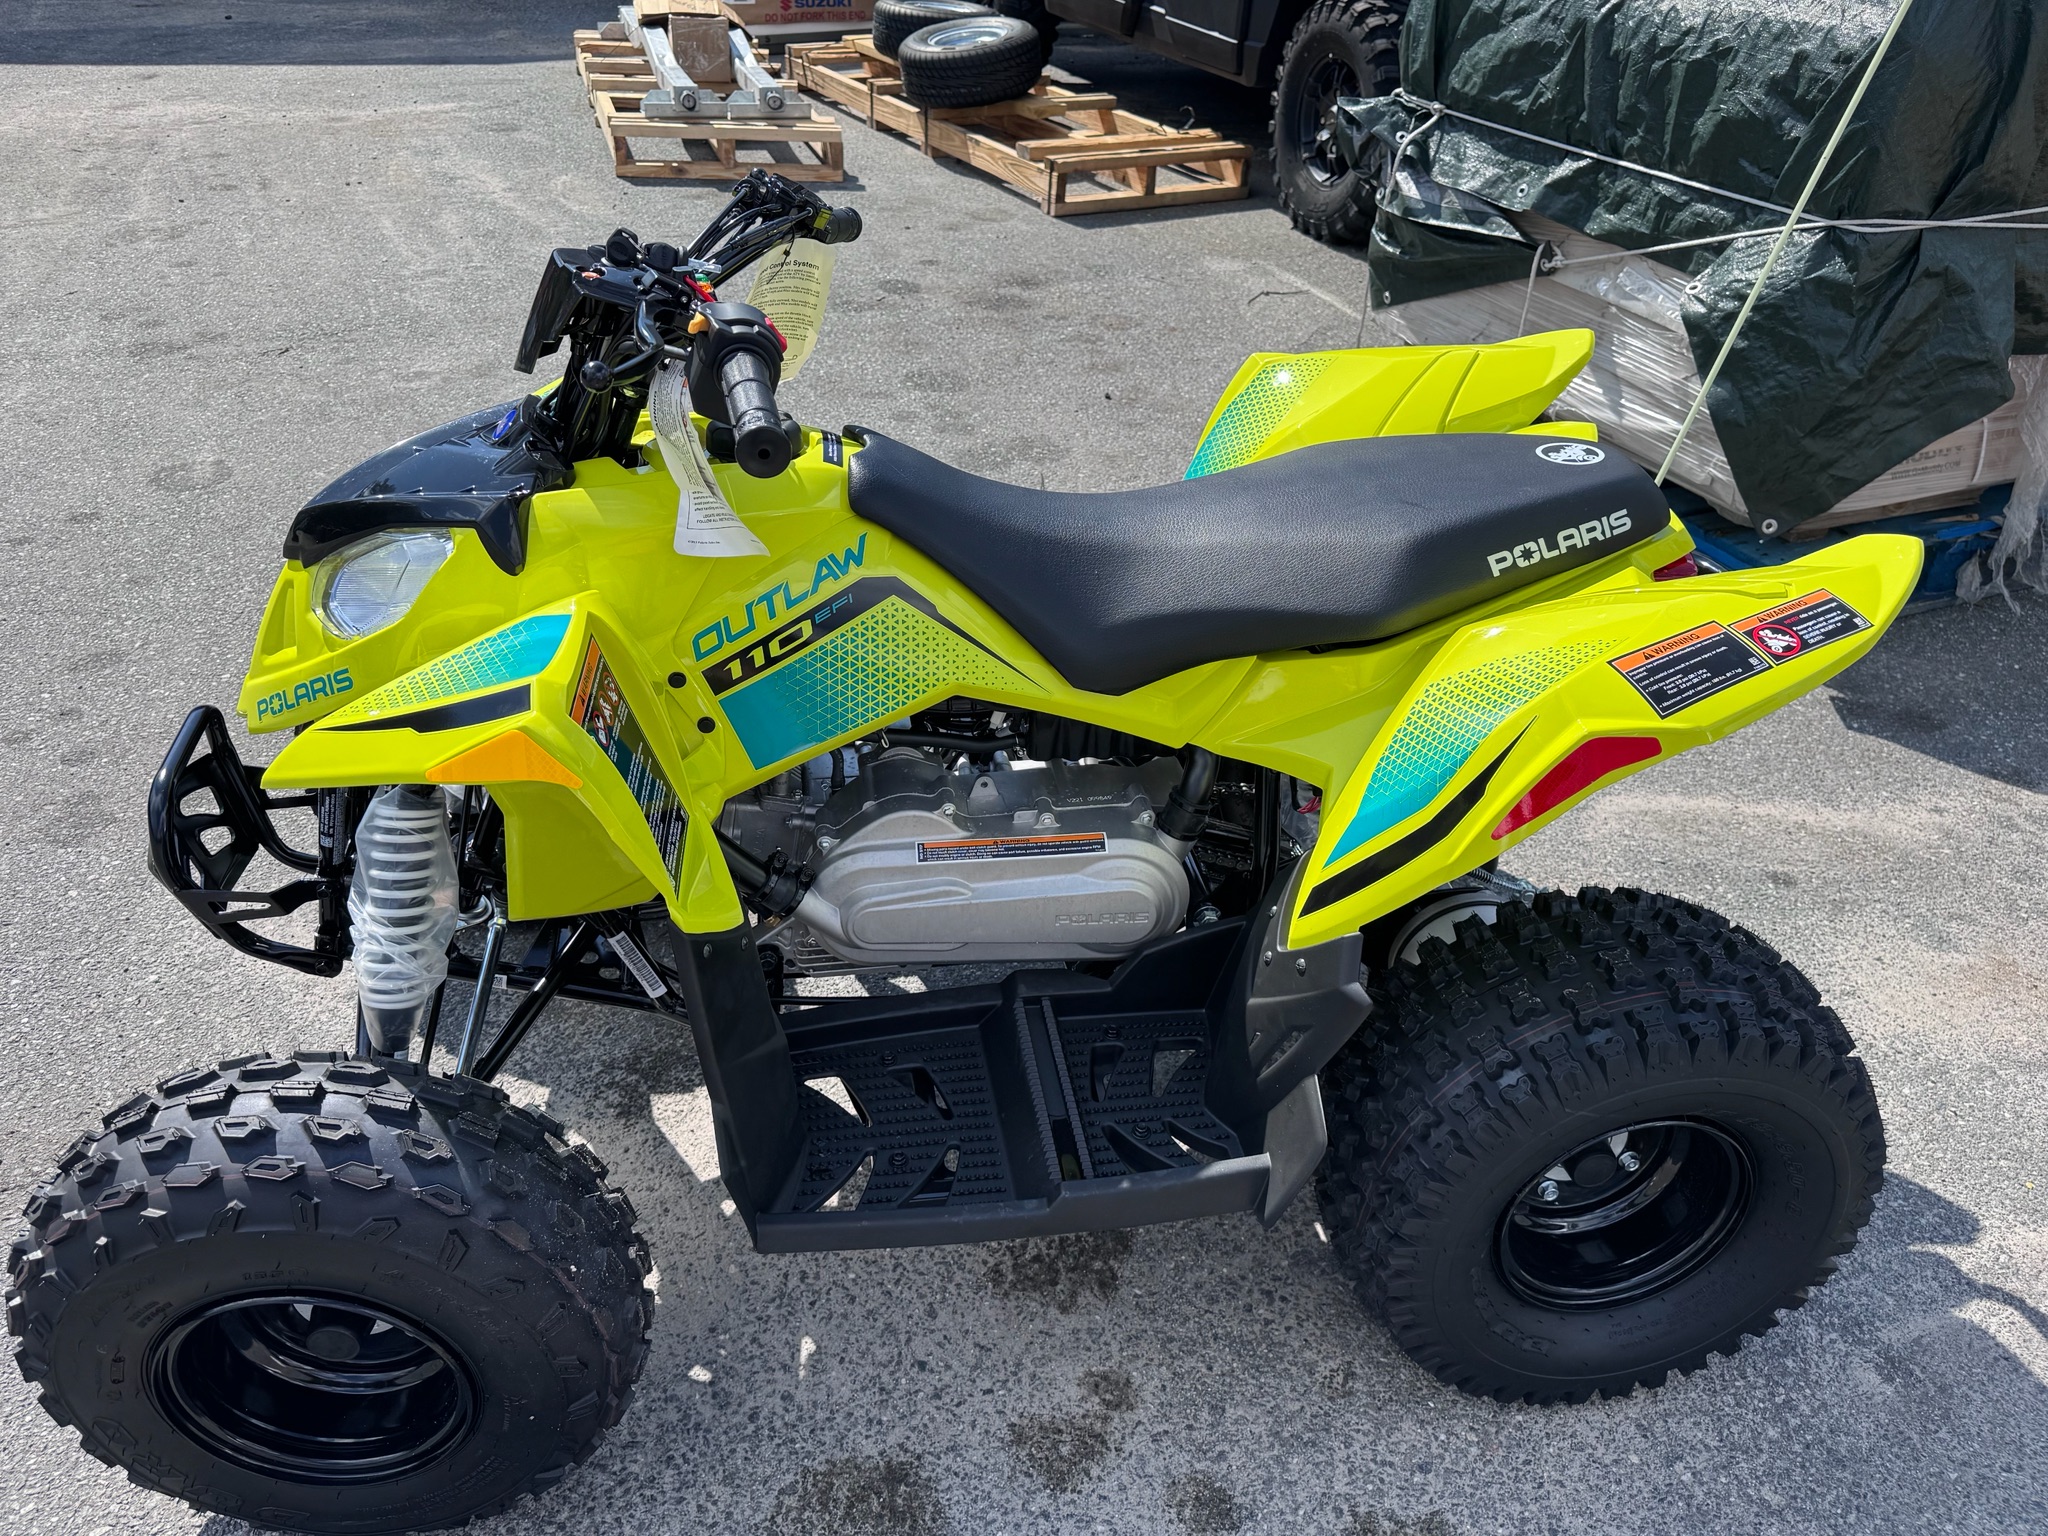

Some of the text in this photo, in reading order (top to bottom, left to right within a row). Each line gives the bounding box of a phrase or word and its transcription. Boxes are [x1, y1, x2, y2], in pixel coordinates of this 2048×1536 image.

[794, 0, 853, 8] SUZUKI
[765, 10, 866, 22] DO NOT FORK THIS END
[793, 260, 819, 270] System
[1487, 508, 1632, 578] POLARIS
[691, 531, 869, 663] OUTLAW
[815, 593, 853, 625] EFI
[1765, 601, 1807, 618] WARNING
[722, 618, 814, 681] 110
[1652, 633, 1700, 654] WARNING
[579, 659, 594, 700] WARNING
[256, 667, 354, 721] POLARIS
[999, 838, 1030, 846] WARNING
[1055, 911, 1150, 927] POLARIS
